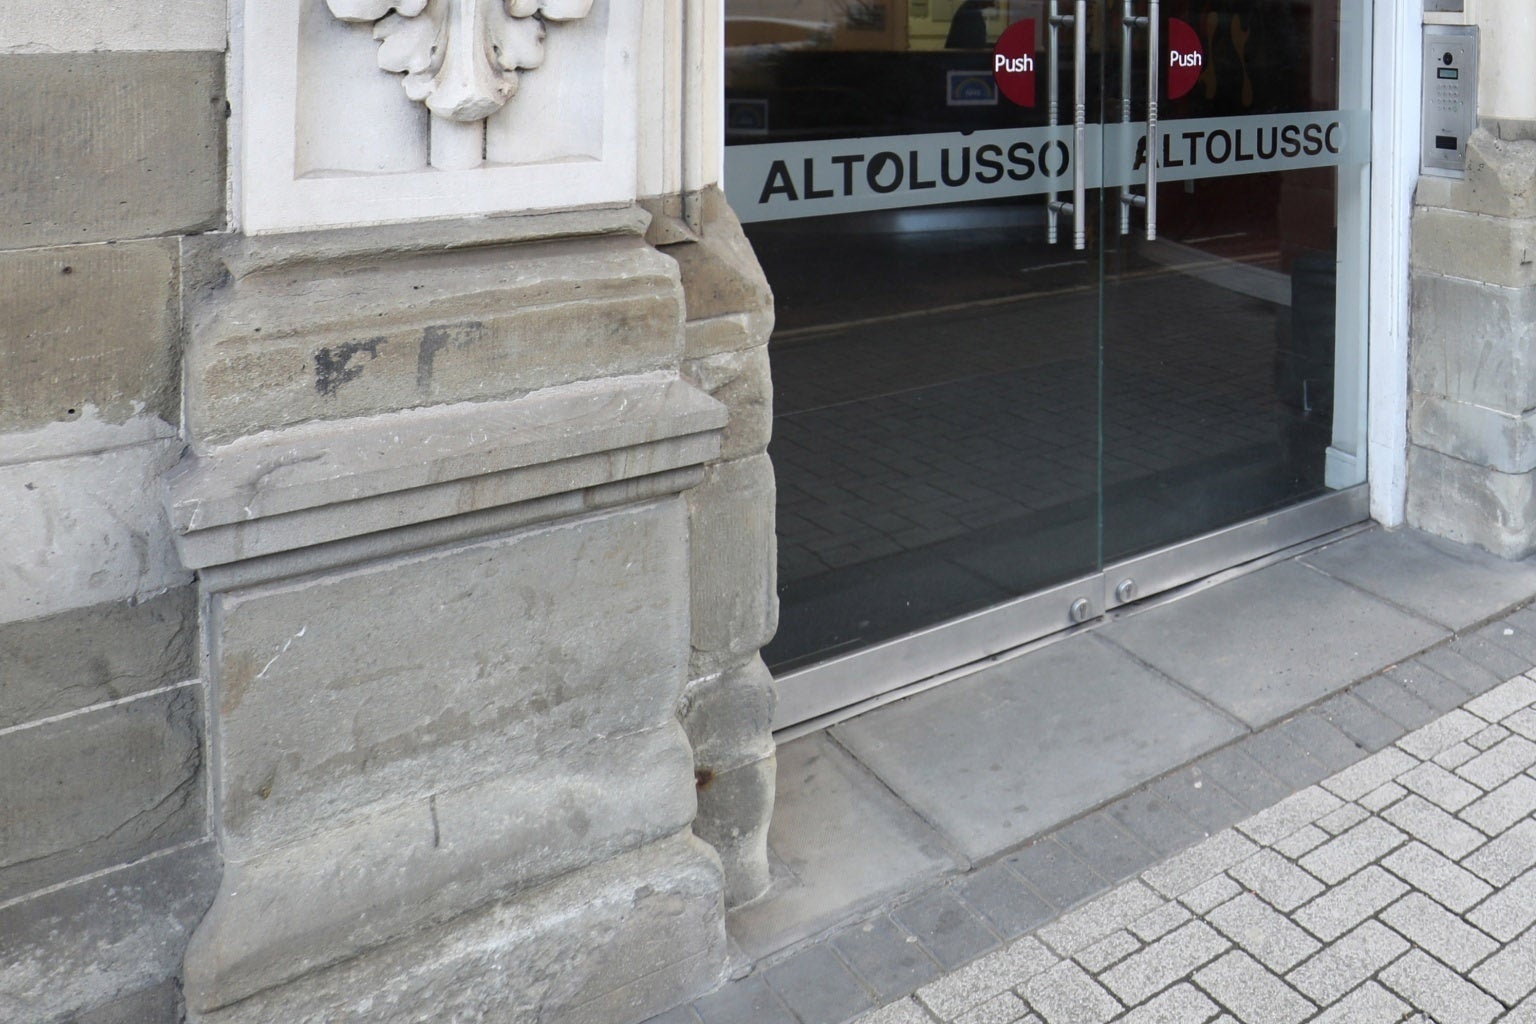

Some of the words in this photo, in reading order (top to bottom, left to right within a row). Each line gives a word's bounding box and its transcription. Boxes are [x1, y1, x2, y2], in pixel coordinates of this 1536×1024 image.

[995, 53, 1033, 73] Push
[1170, 50, 1201, 67] Push
[758, 139, 1070, 204] ALTOLUSSO
